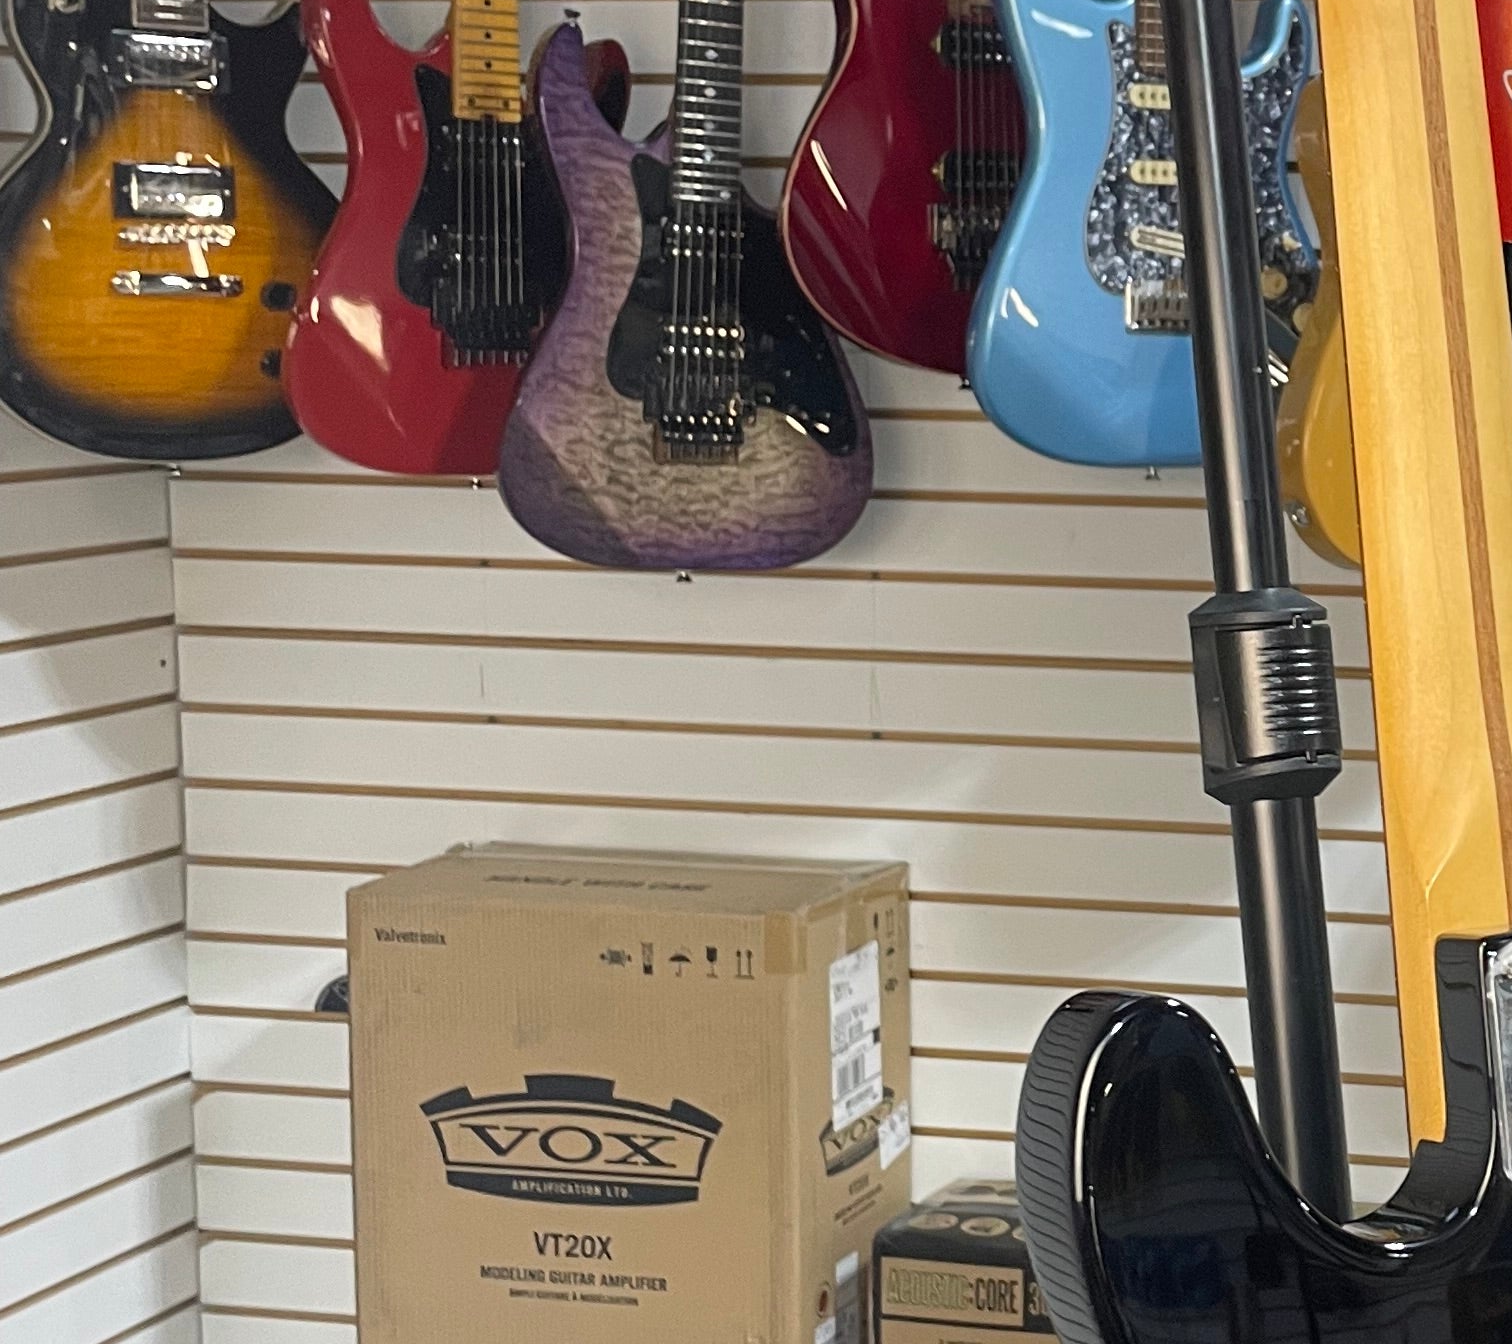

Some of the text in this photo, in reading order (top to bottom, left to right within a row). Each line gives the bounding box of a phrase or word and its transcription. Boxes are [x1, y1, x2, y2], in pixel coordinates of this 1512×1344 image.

[459, 1123, 677, 1169] VOX
[511, 1179, 601, 1197] AMPLIFICATION
[534, 1230, 614, 1261] VT20X
[480, 1264, 668, 1292] MODELING GUITAR AMPLIFIER
